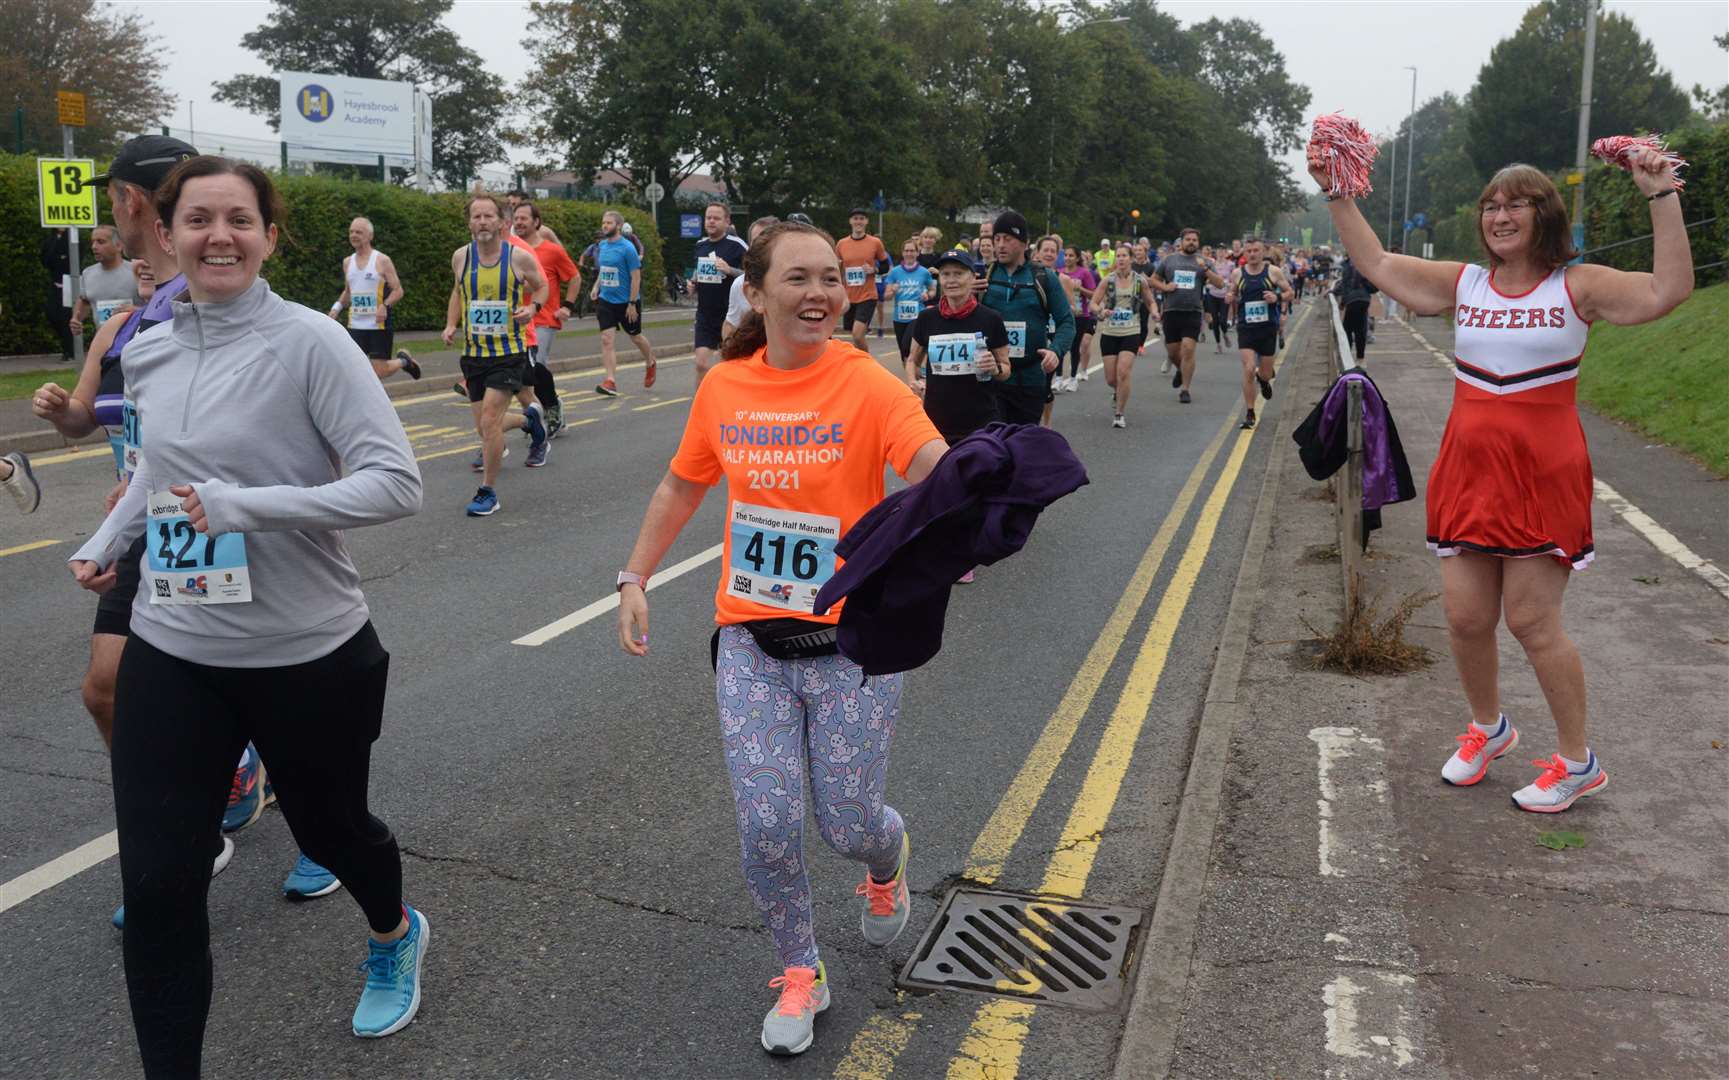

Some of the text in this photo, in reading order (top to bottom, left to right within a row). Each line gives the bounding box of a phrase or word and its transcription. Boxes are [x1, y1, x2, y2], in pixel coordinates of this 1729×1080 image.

[343, 99, 400, 113] Hayesbrook
[343, 113, 387, 127] Academy
[48, 166, 83, 195] 13
[48, 205, 91, 220] MILES
[474, 309, 503, 324] 212
[1457, 304, 1566, 329] CHEERS
[936, 343, 969, 362] 714
[749, 410, 820, 422] ANNIVERSARY
[719, 423, 844, 446] TONBRIDGE
[723, 447, 844, 465] ALF MARATHON
[747, 469, 800, 490] 2021
[736, 511, 835, 535] The Tonbridge Half Marathon
[744, 531, 818, 580] 416
